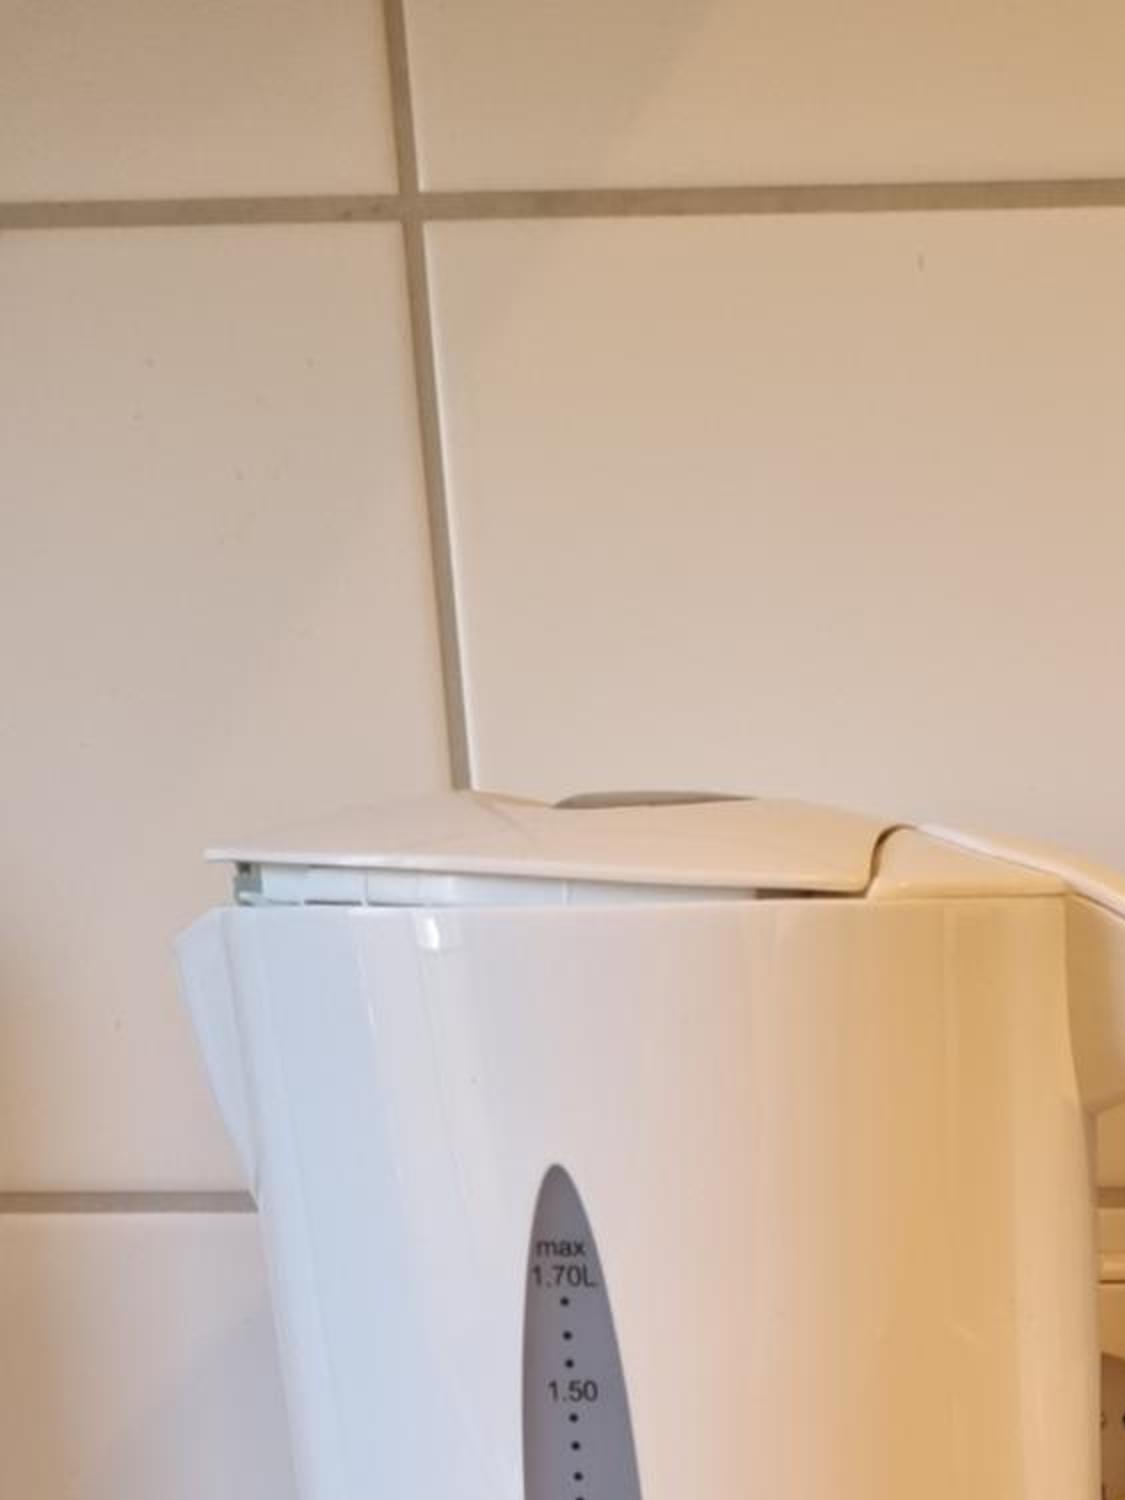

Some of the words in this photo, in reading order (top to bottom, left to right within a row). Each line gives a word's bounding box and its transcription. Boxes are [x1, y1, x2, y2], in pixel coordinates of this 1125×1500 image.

[535, 1240, 586, 1258] max
[532, 1264, 597, 1288] 1.70L
[548, 1380, 599, 1402] 1.50
